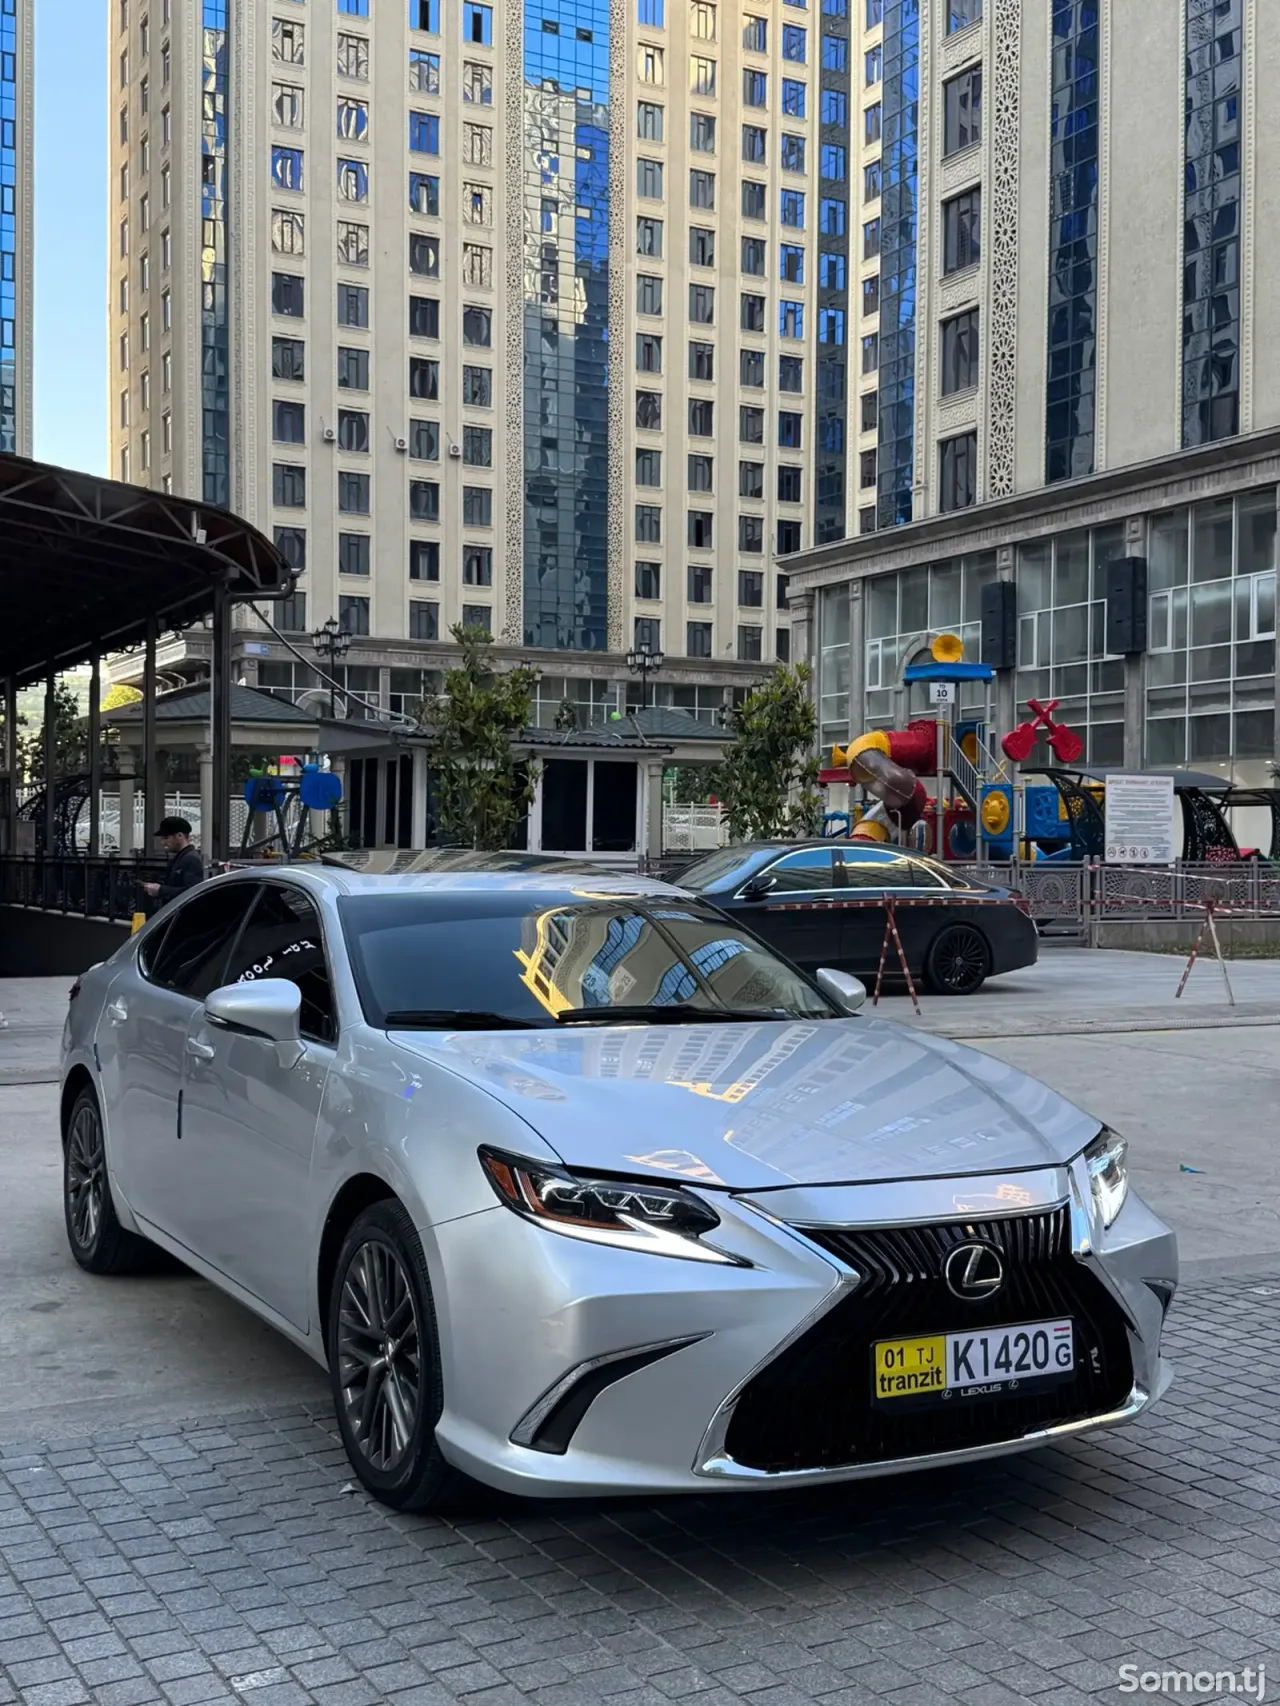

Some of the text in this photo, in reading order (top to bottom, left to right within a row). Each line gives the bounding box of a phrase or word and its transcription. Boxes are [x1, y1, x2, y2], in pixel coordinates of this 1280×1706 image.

[937, 689, 948, 697] 10
[884, 1347, 934, 1368] 01 TJ
[953, 1330, 1071, 1382] K1420 G
[879, 1366, 943, 1392] tranzit
[961, 1383, 1002, 1397] LEXUS
